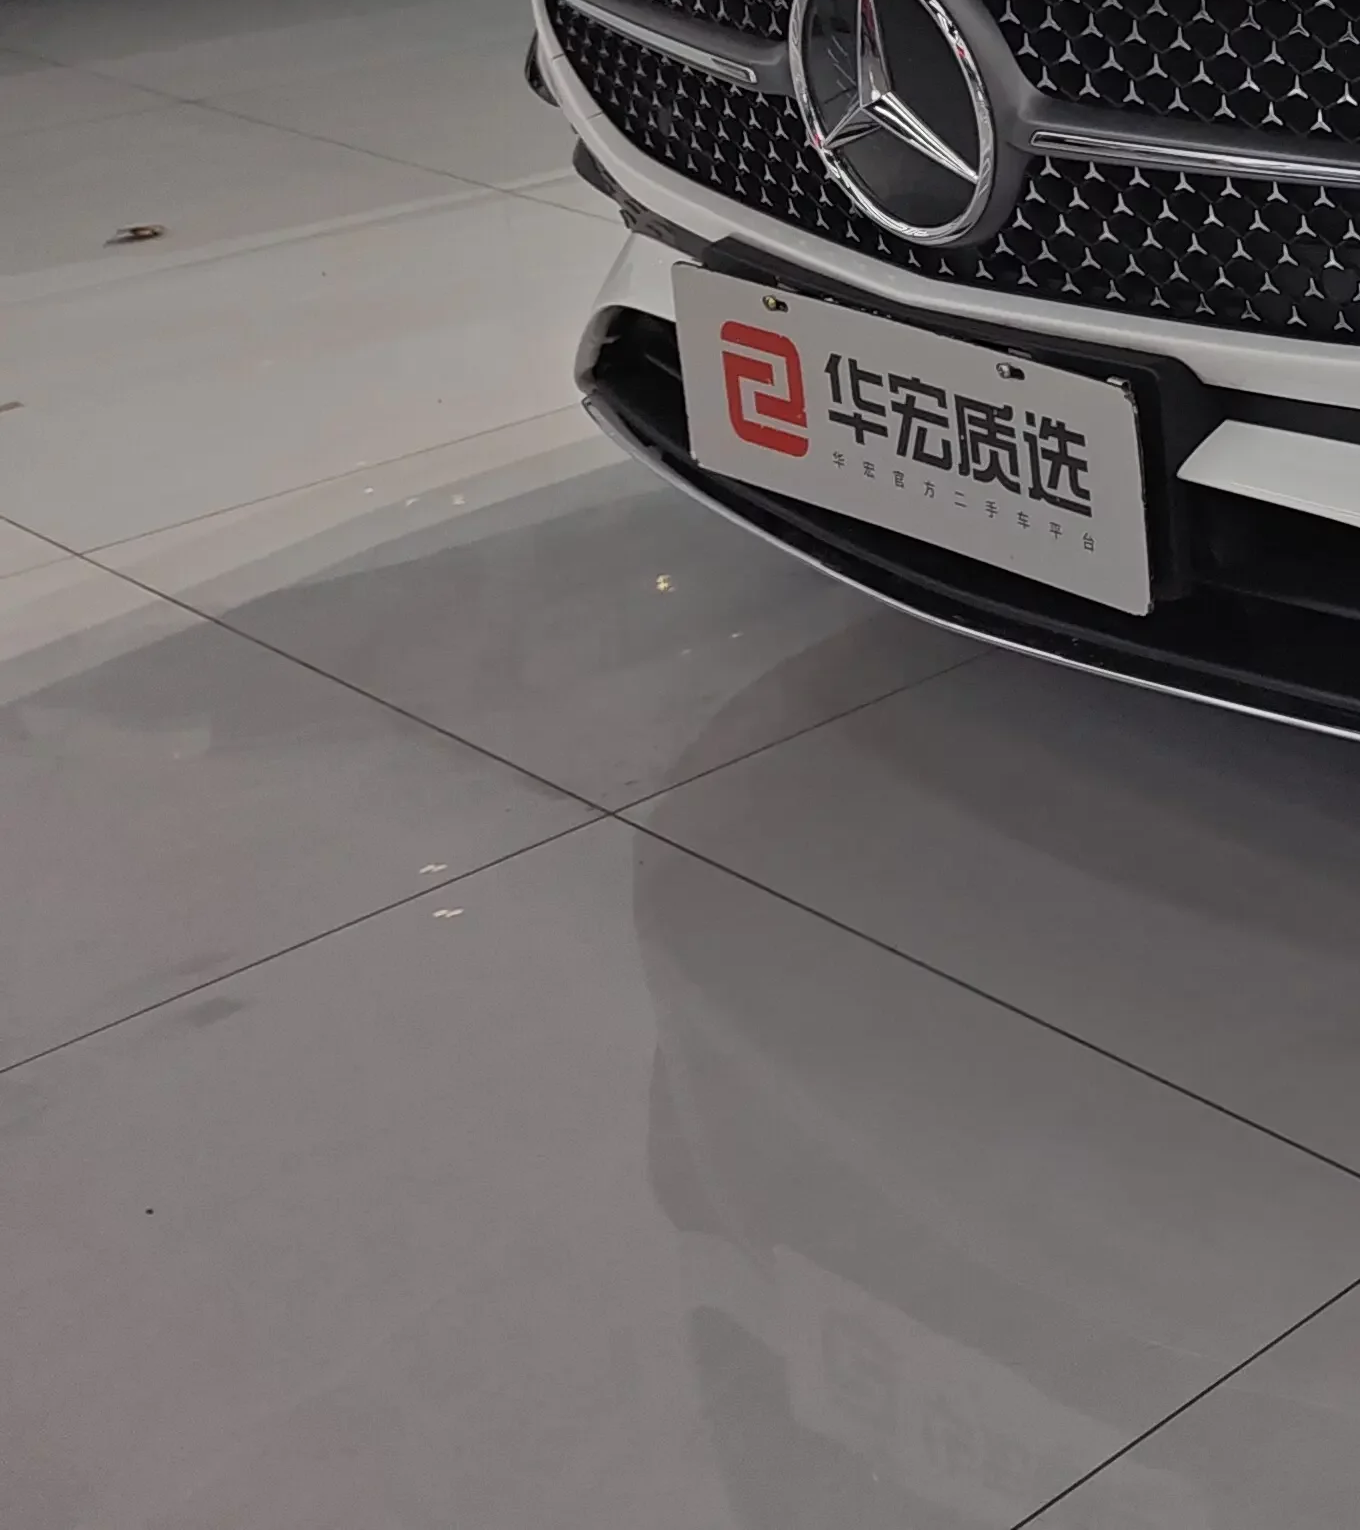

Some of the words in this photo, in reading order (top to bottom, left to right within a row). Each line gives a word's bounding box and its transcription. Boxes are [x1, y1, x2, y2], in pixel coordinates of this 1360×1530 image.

[824, 352, 1093, 517] 华宏质选
[832, 451, 1096, 554] 华宏官方二手车平台
